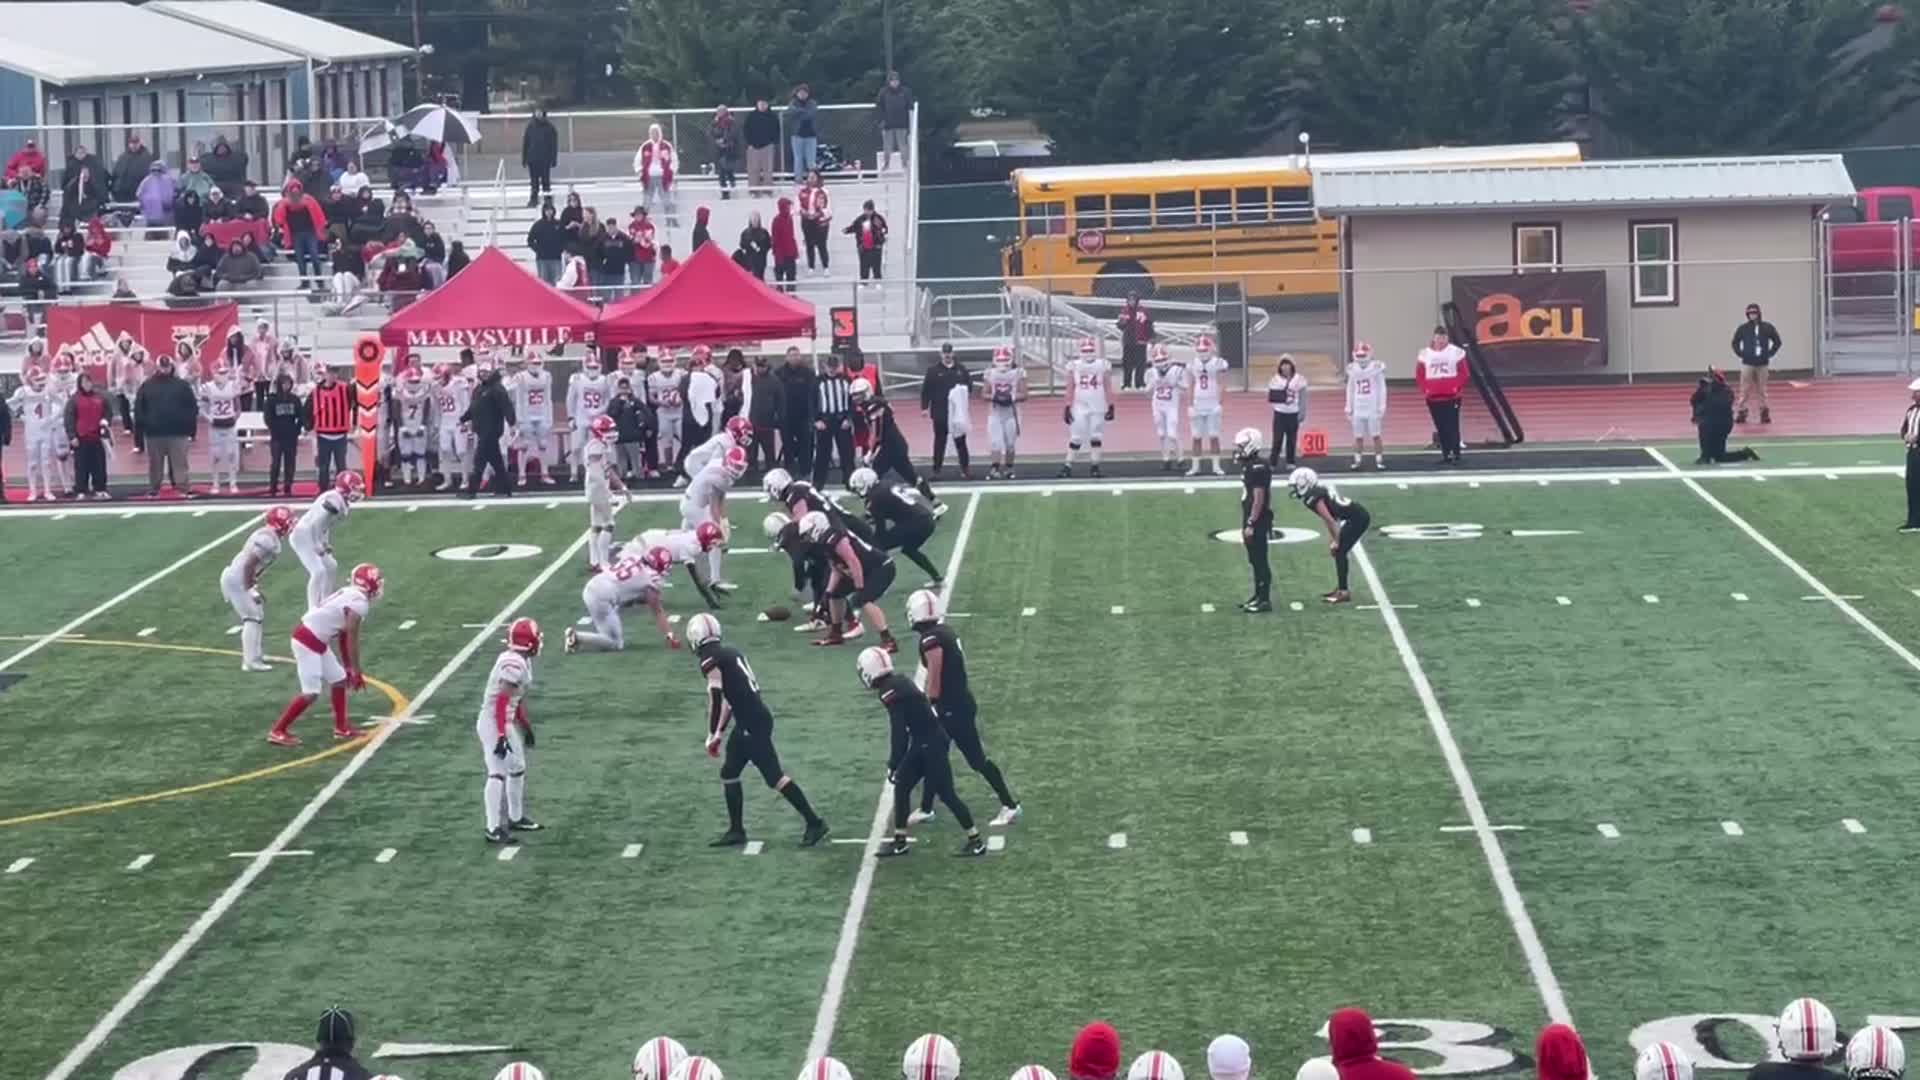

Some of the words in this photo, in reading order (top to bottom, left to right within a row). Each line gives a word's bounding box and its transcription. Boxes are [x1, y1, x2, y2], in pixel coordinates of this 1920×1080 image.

[833, 311, 855, 337] 3
[1476, 293, 1583, 344] acu
[407, 326, 572, 346] MARYSVILLE
[1303, 433, 1325, 452] 30
